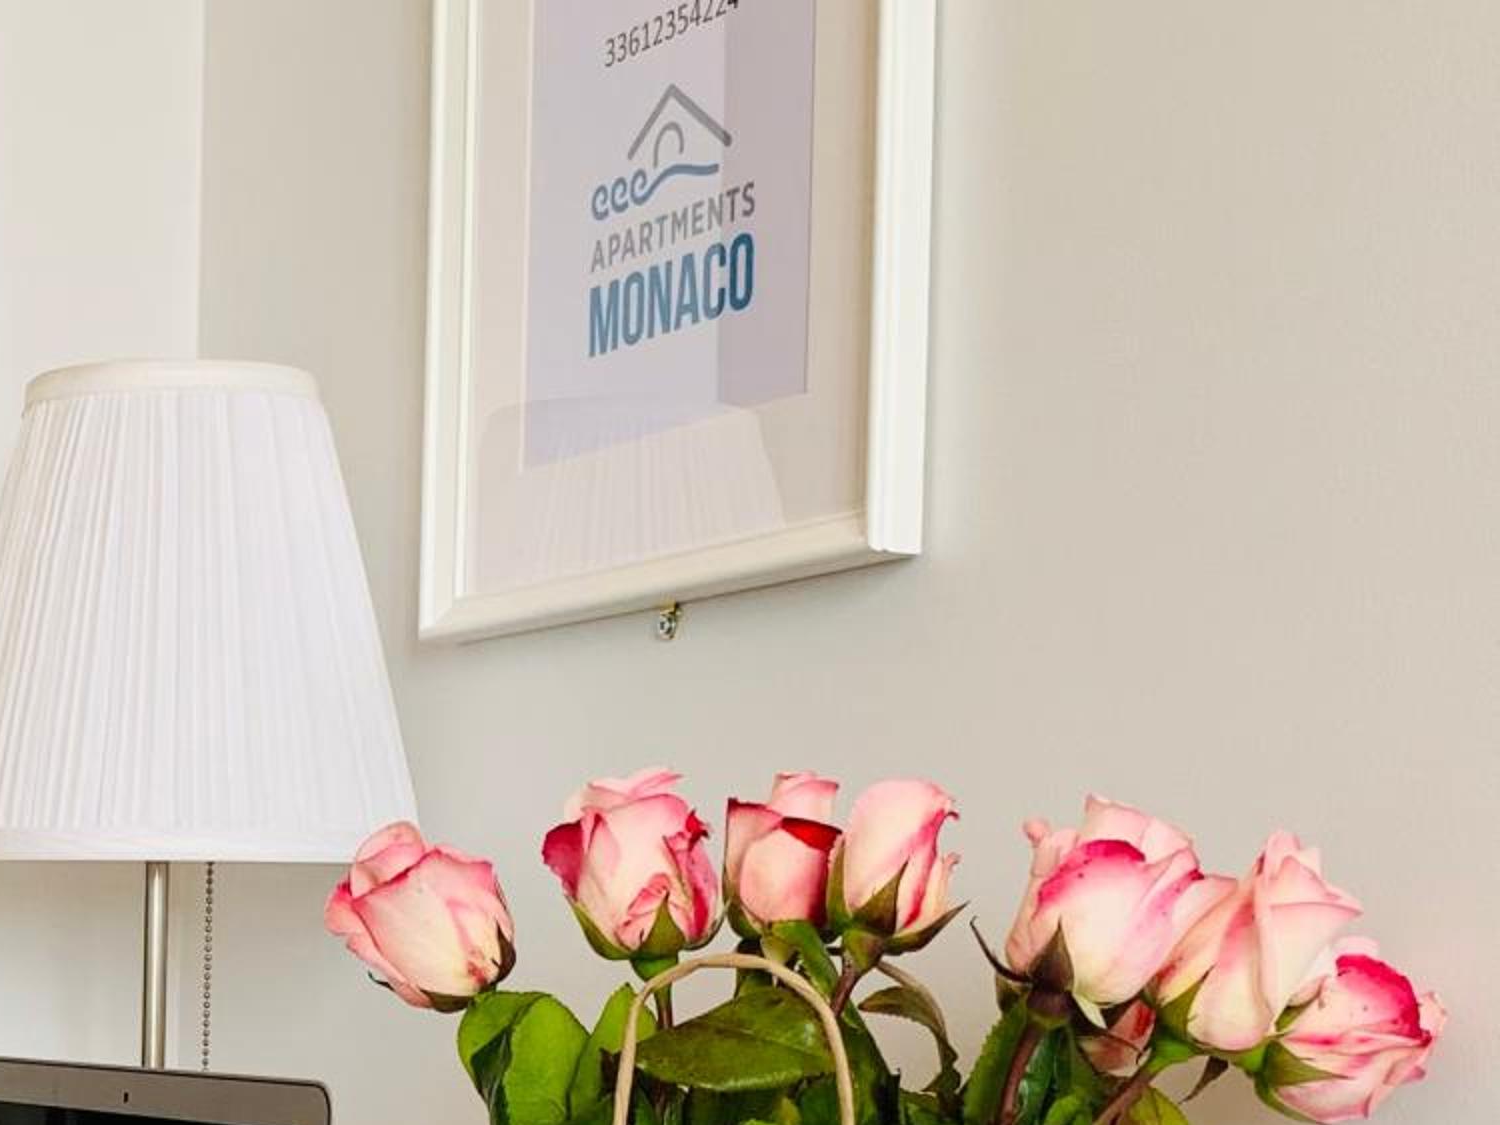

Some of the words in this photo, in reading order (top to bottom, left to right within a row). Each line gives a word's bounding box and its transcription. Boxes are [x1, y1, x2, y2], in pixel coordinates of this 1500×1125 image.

[604, 0, 739, 67] 3361235422
[590, 182, 755, 273] APARTMENTS
[588, 233, 754, 358] MONACO
